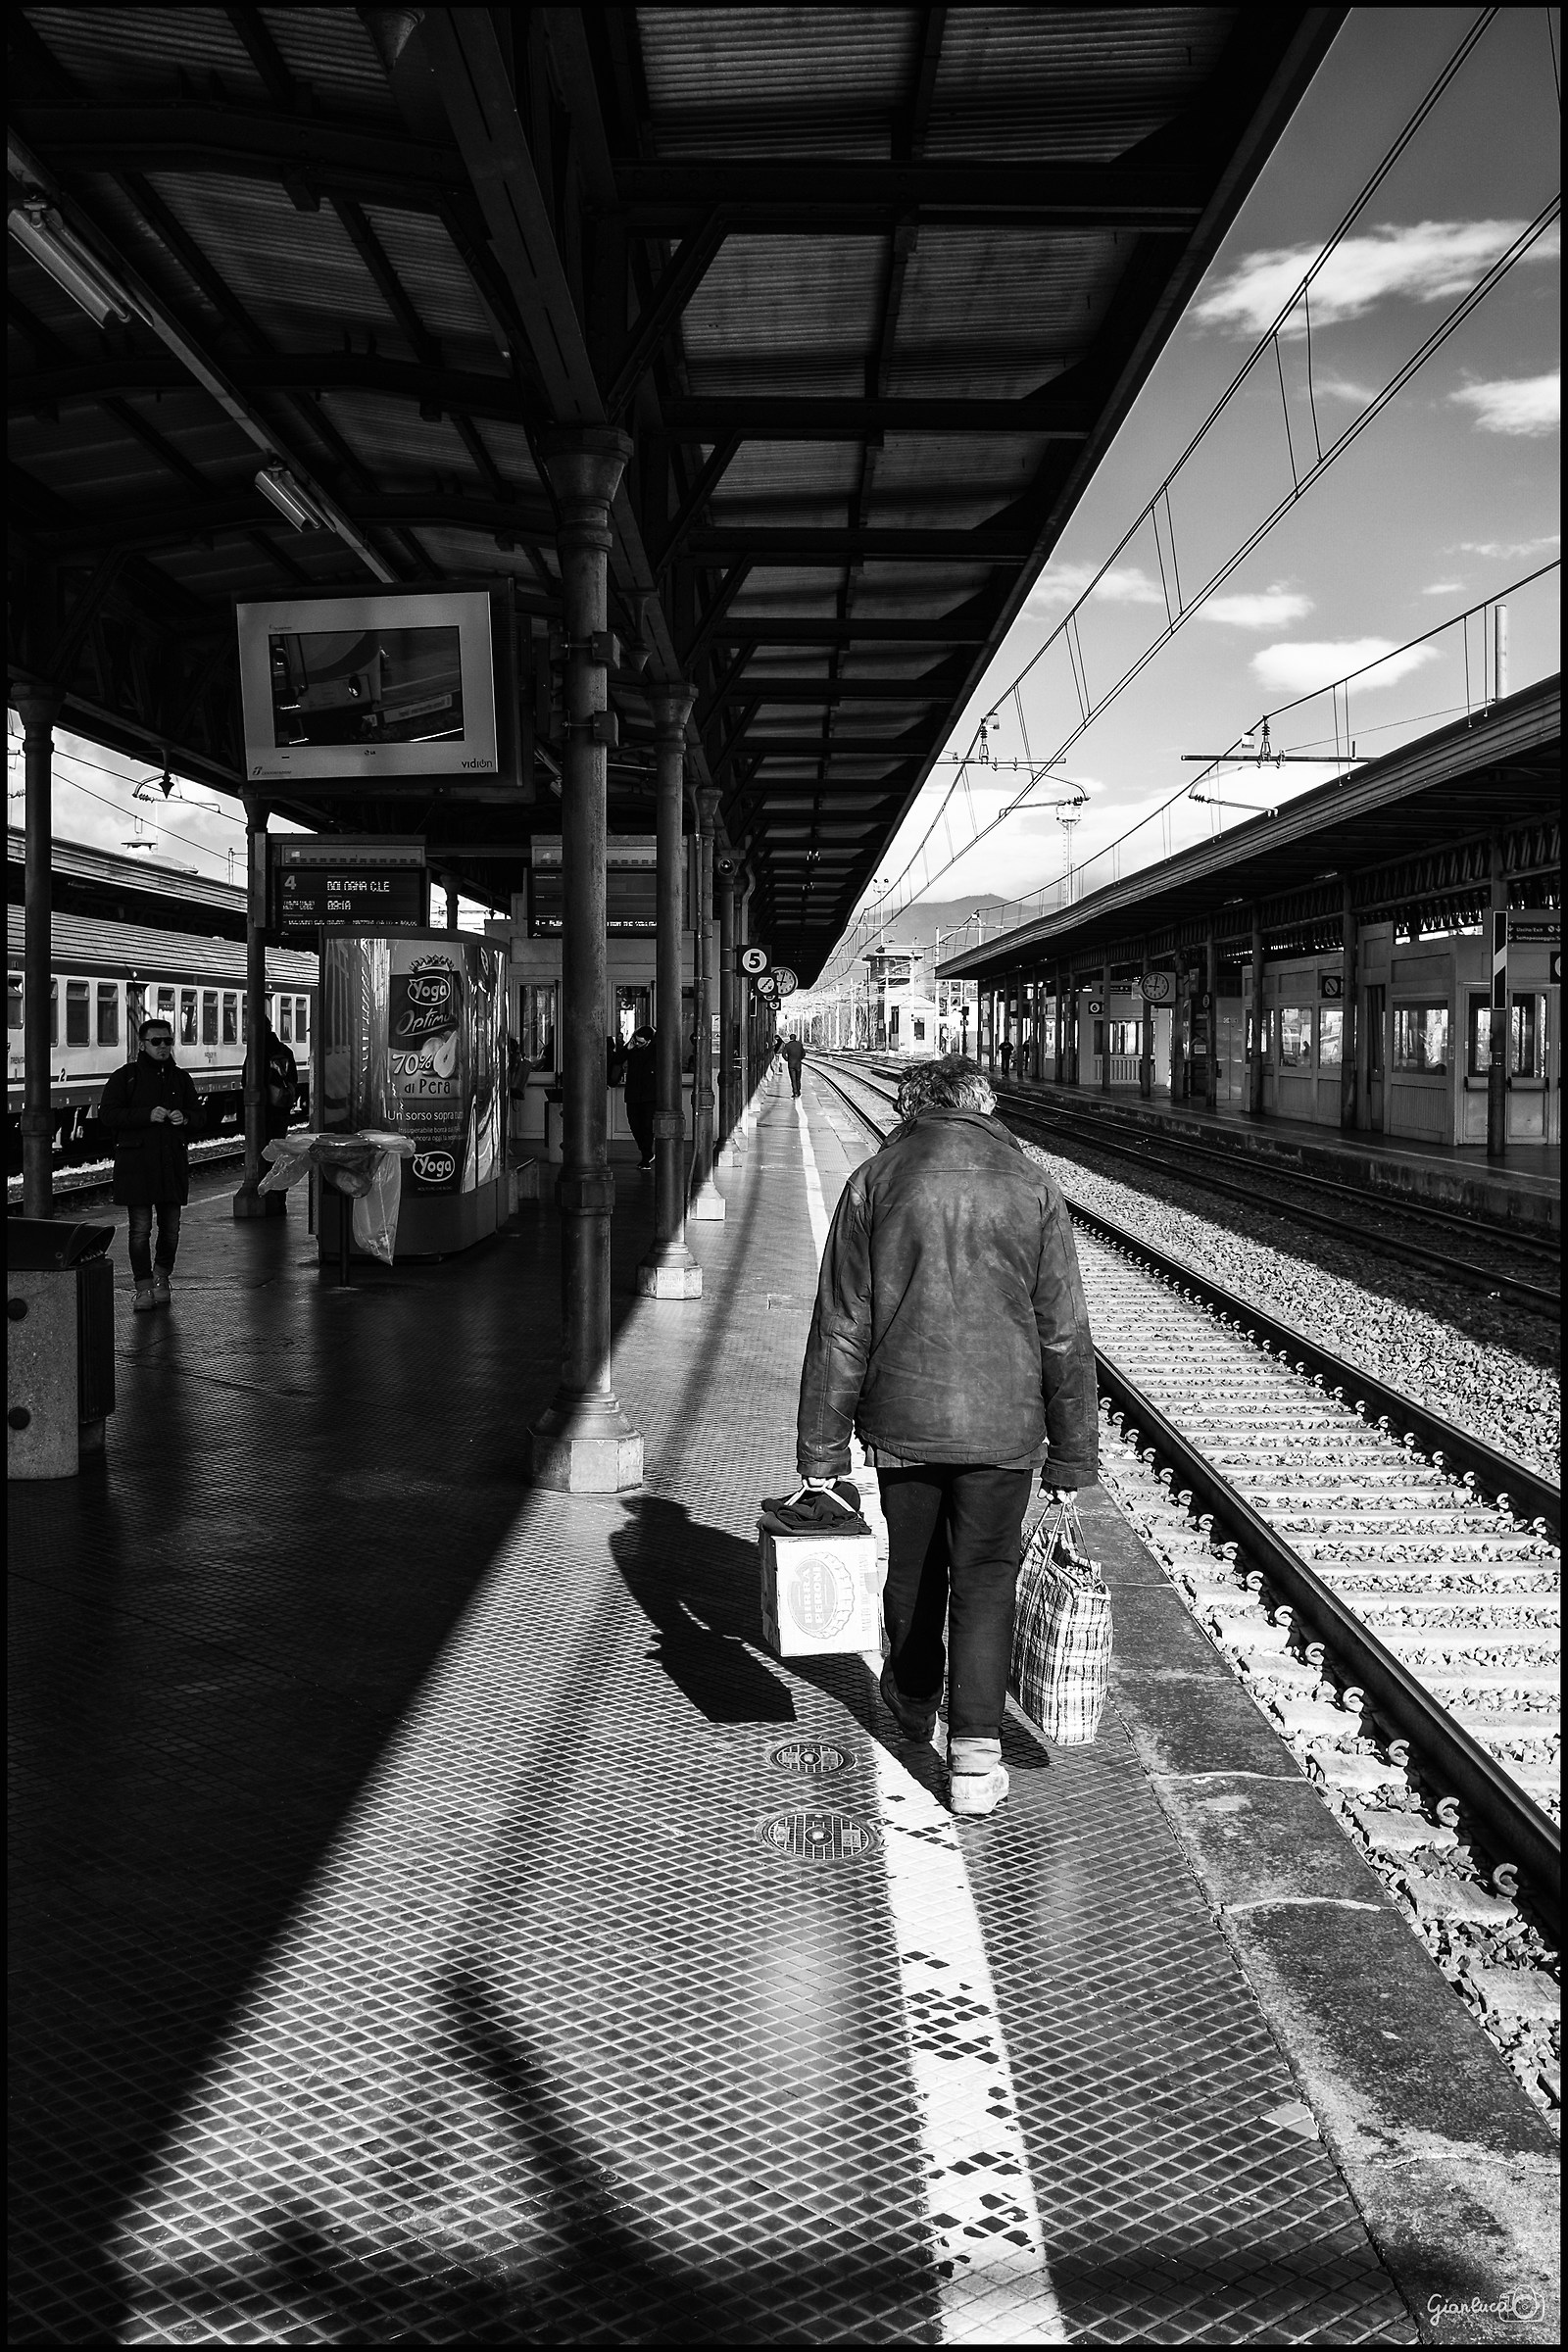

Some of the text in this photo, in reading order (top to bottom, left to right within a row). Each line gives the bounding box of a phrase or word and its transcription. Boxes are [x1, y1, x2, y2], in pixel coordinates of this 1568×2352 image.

[461, 758, 493, 768] vidion
[284, 875, 297, 890] 4
[749, 953, 760, 969] 5
[413, 980, 447, 1002] Yoga
[395, 1007, 454, 1035] Optimu
[392, 1053, 433, 1075] 70%
[60, 1067, 66, 1082] 2
[404, 1079, 451, 1095] di Pera
[387, 1110, 403, 1121] Un
[405, 1111, 432, 1121] sorso
[433, 1111, 454, 1123] sopra
[418, 1156, 452, 1177] Yoga
[803, 1568, 812, 1624] BIRRA
[812, 1566, 823, 1624] PERONI
